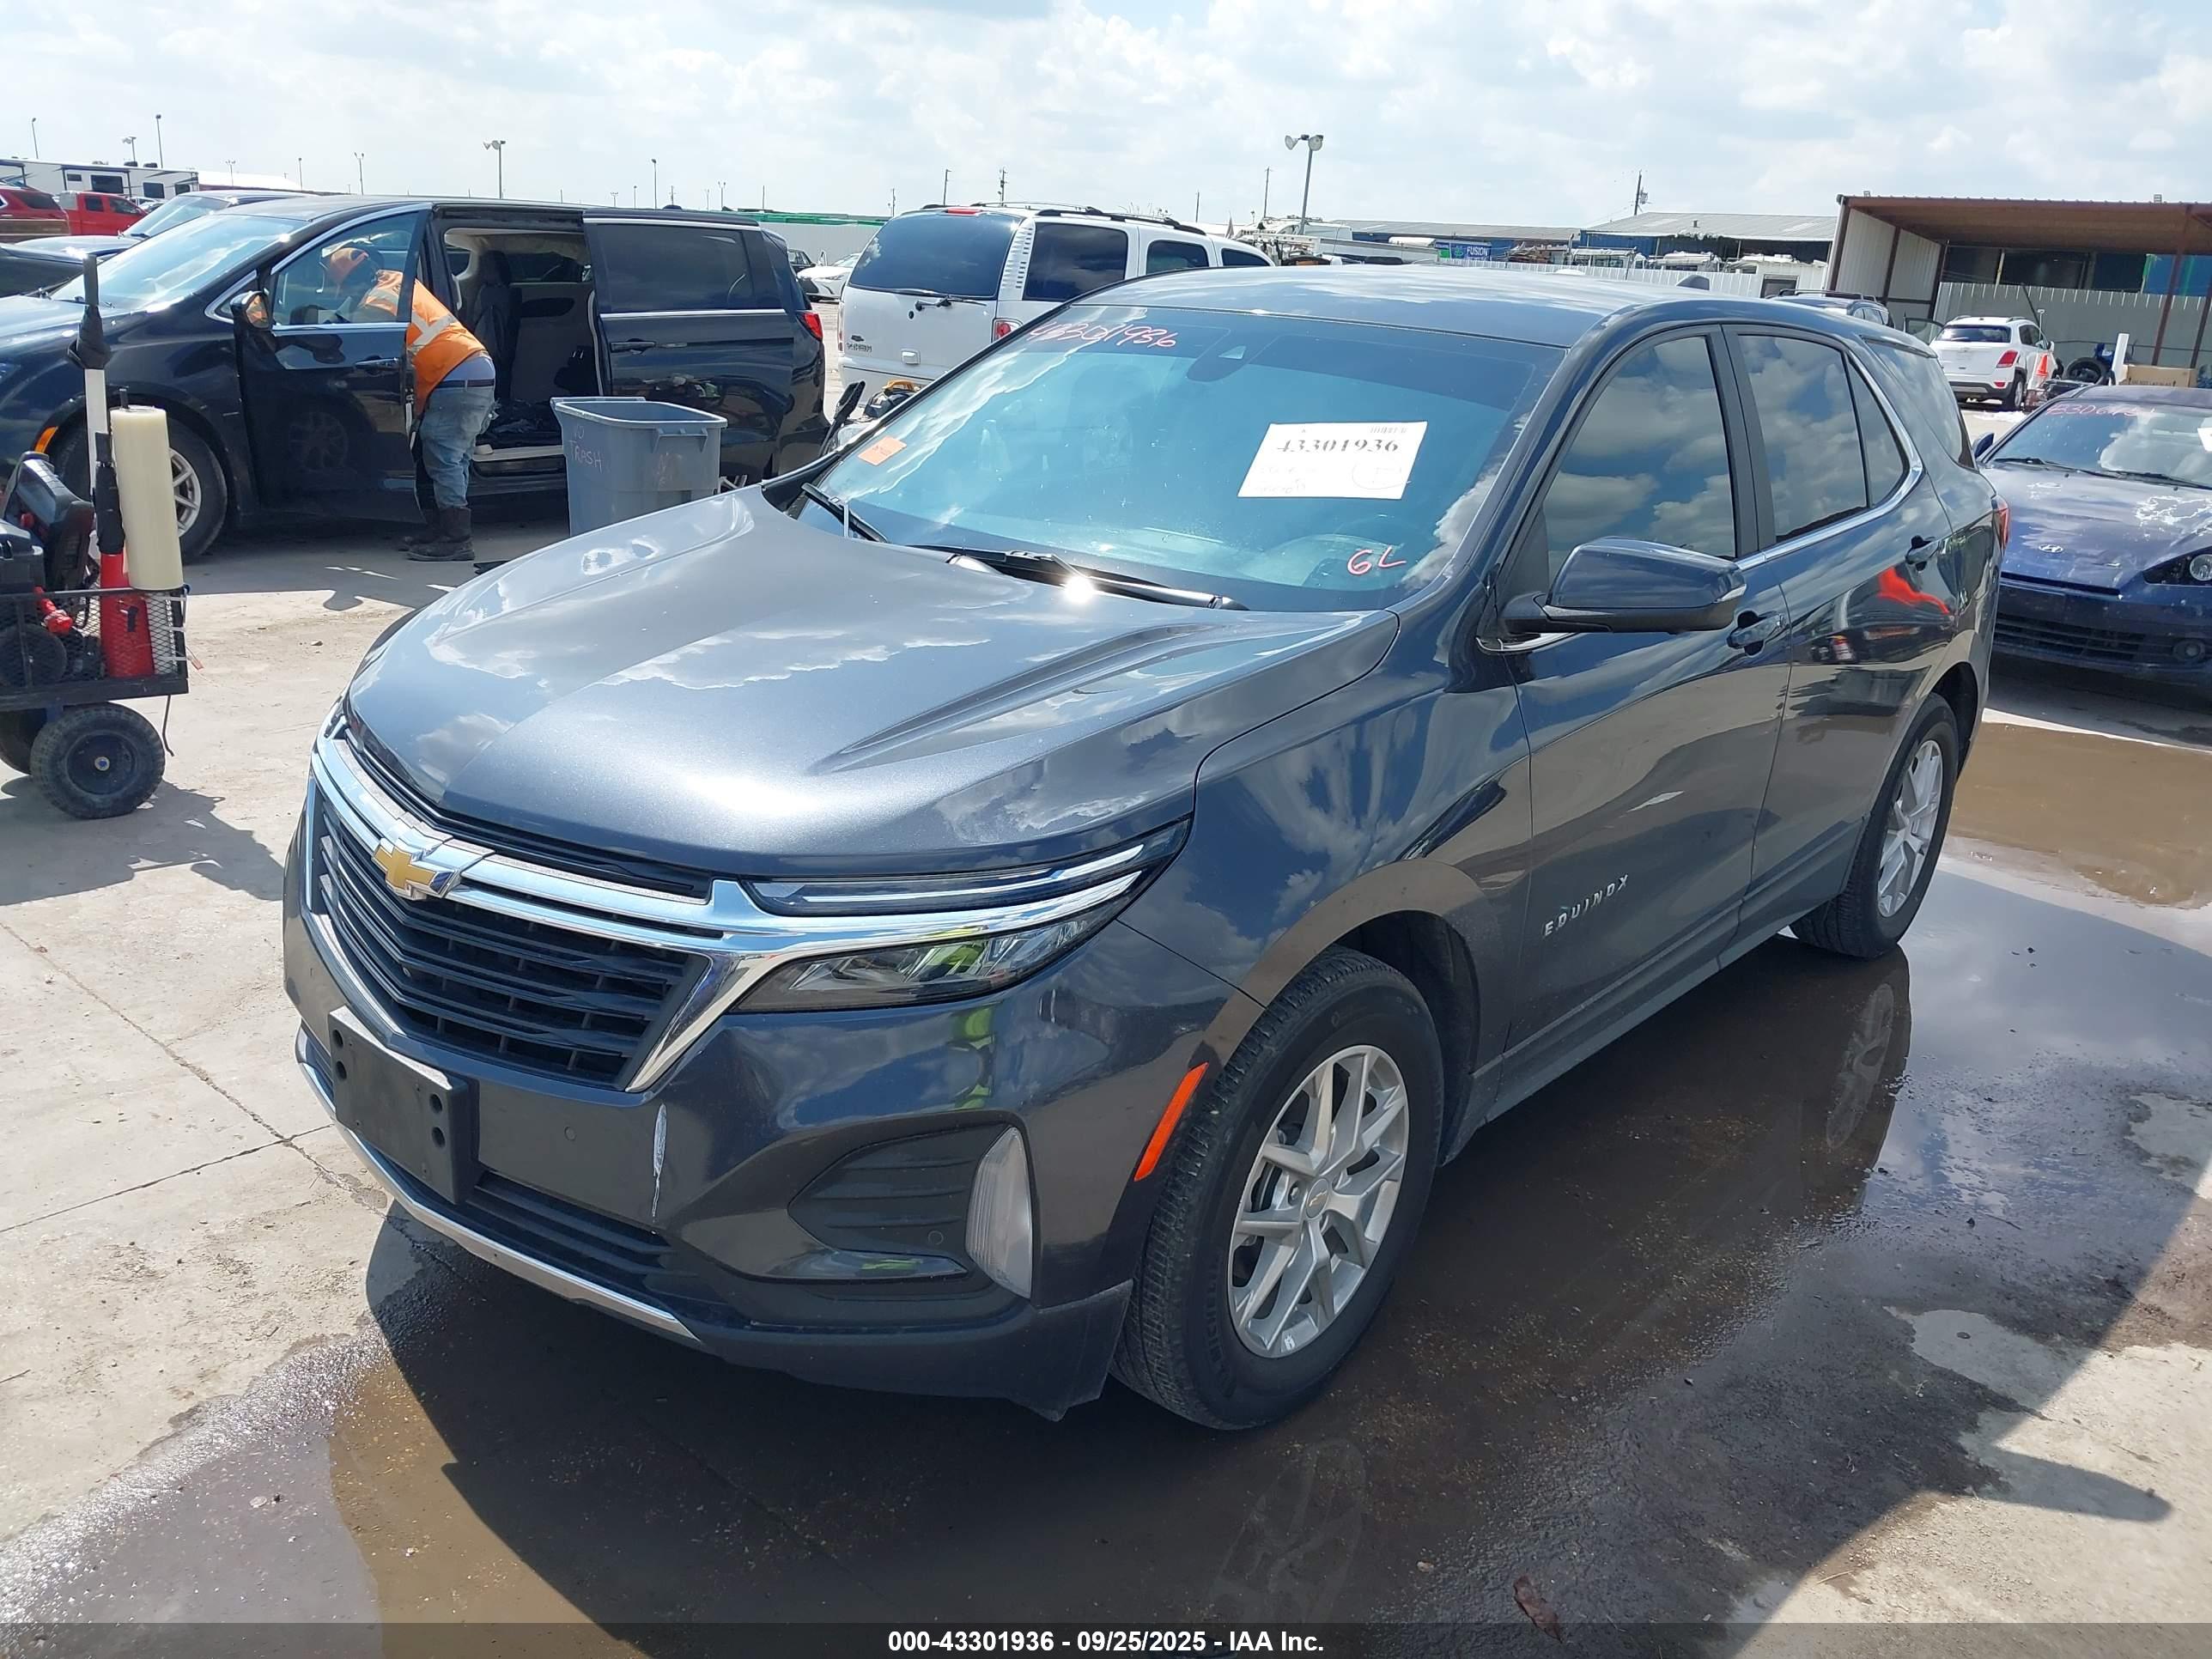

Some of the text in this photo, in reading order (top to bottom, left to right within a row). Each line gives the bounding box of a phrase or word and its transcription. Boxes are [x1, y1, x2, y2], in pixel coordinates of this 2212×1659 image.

[1467, 246, 1488, 257] FUSION
[569, 440, 602, 473] TRASH
[1277, 439, 1399, 452] 43301936
[1545, 874, 1628, 936] EQUINOX
